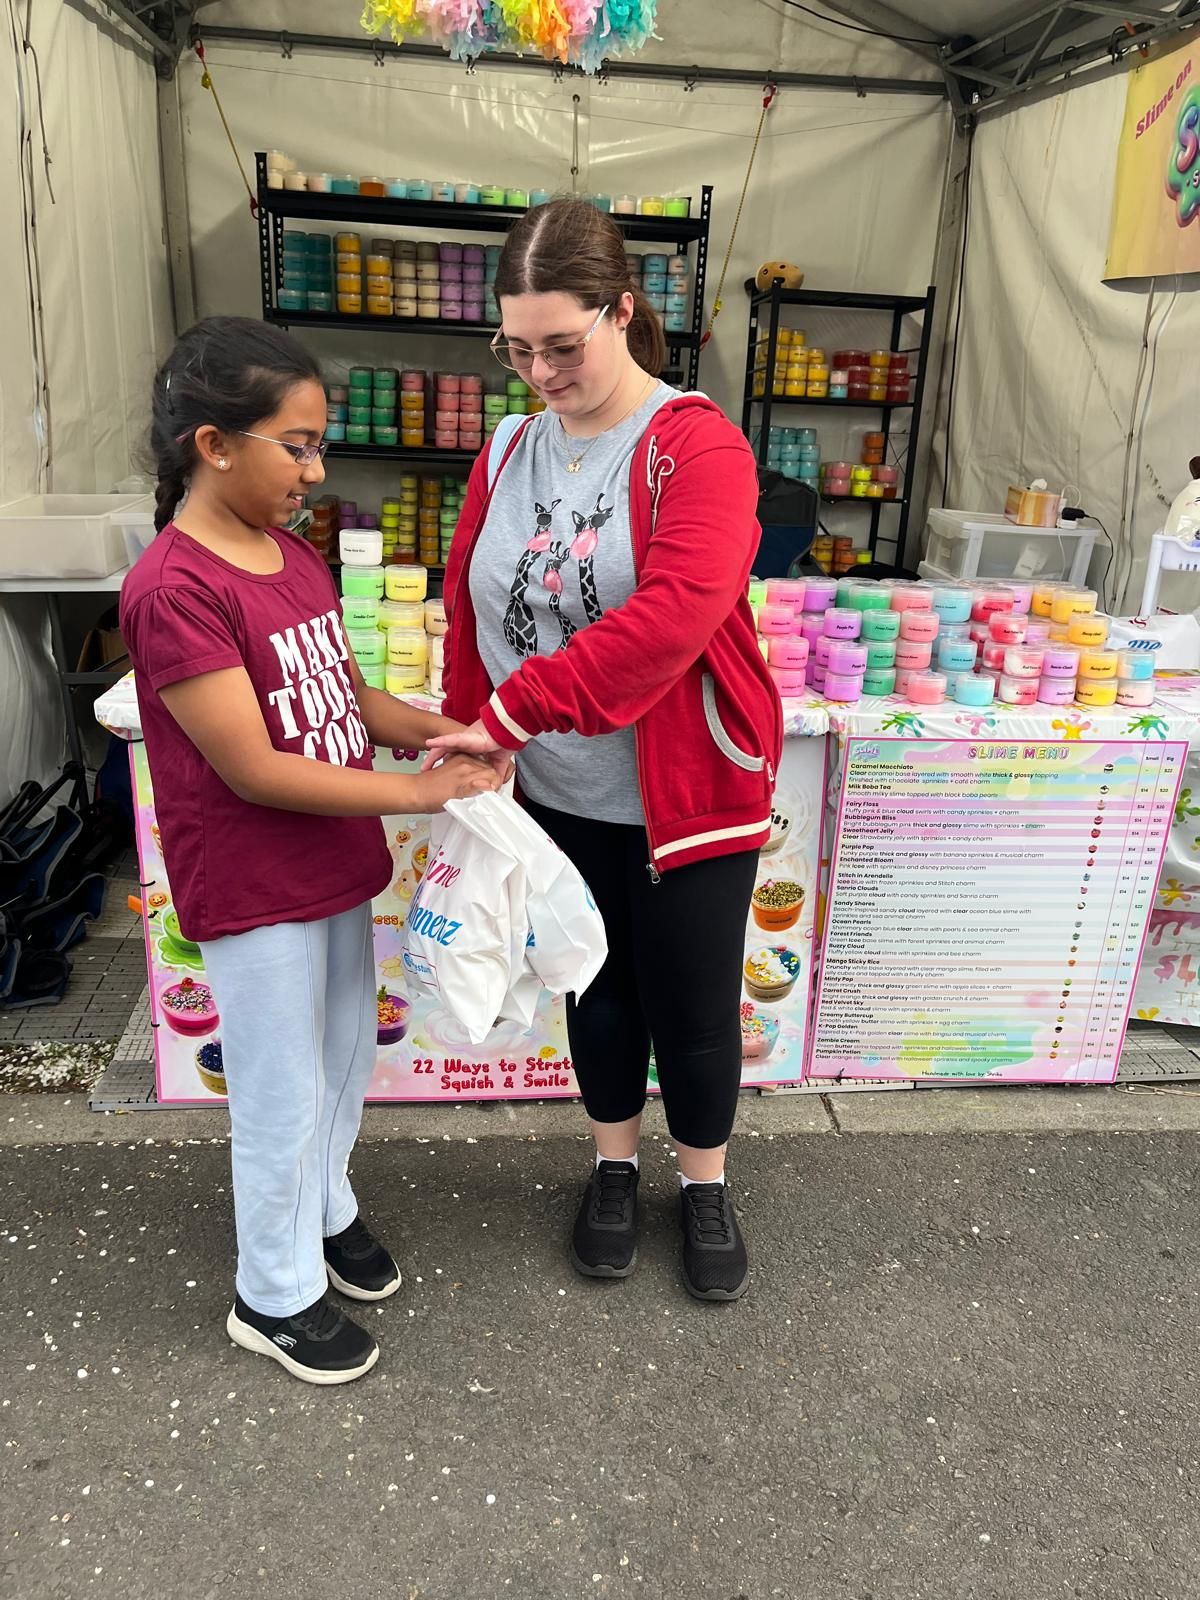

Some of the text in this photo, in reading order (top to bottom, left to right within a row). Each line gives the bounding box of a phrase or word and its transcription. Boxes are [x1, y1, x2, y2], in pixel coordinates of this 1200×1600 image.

[1136, 60, 1192, 140] Slime on
[968, 746, 1070, 760] SLIME MENU
[1154, 954, 1200, 988] SL
[413, 1058, 434, 1074] 22
[444, 1058, 490, 1075] Ways
[499, 1058, 516, 1072] to
[441, 1074, 569, 1093] Squish & Smile
